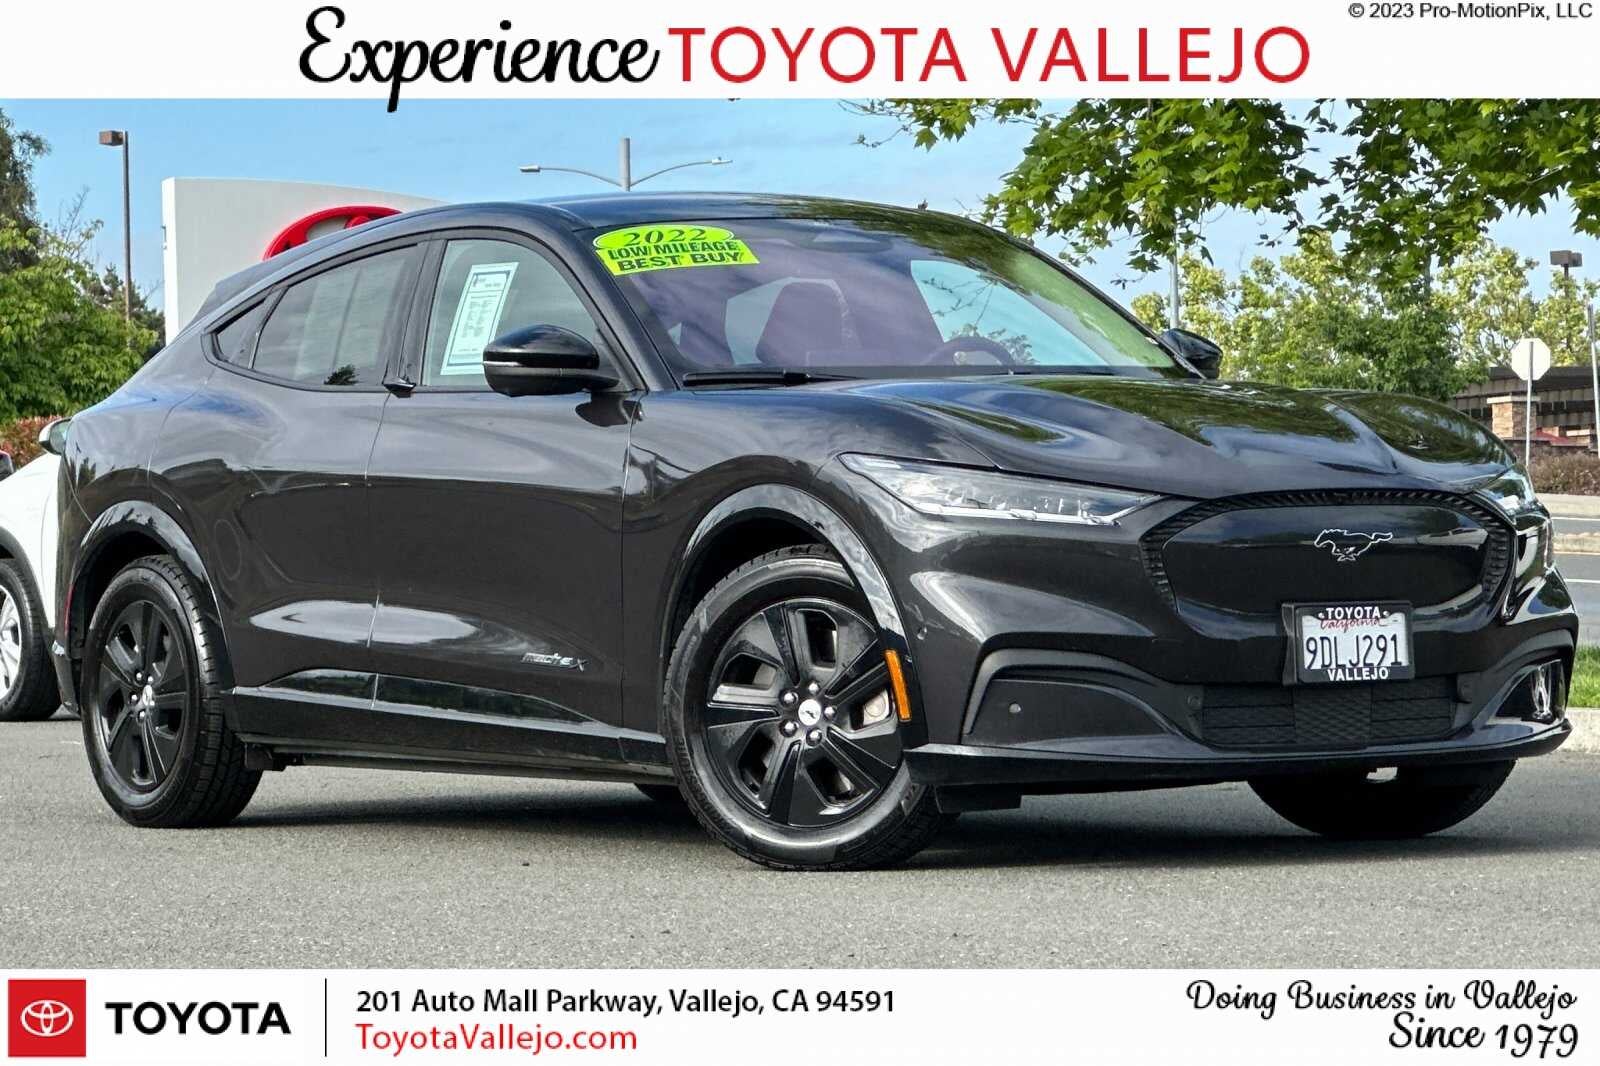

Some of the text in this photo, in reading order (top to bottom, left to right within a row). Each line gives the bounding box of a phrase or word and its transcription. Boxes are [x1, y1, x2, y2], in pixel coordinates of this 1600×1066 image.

[624, 229, 707, 246] 2022
[608, 241, 738, 260] LOW MILEAGE
[617, 251, 741, 272] BEST BUY
[1326, 606, 1381, 620] TOYOTA
[1320, 618, 1381, 633] California
[1306, 633, 1402, 670] 9DLJ291
[1327, 667, 1389, 682] VALLEJO
